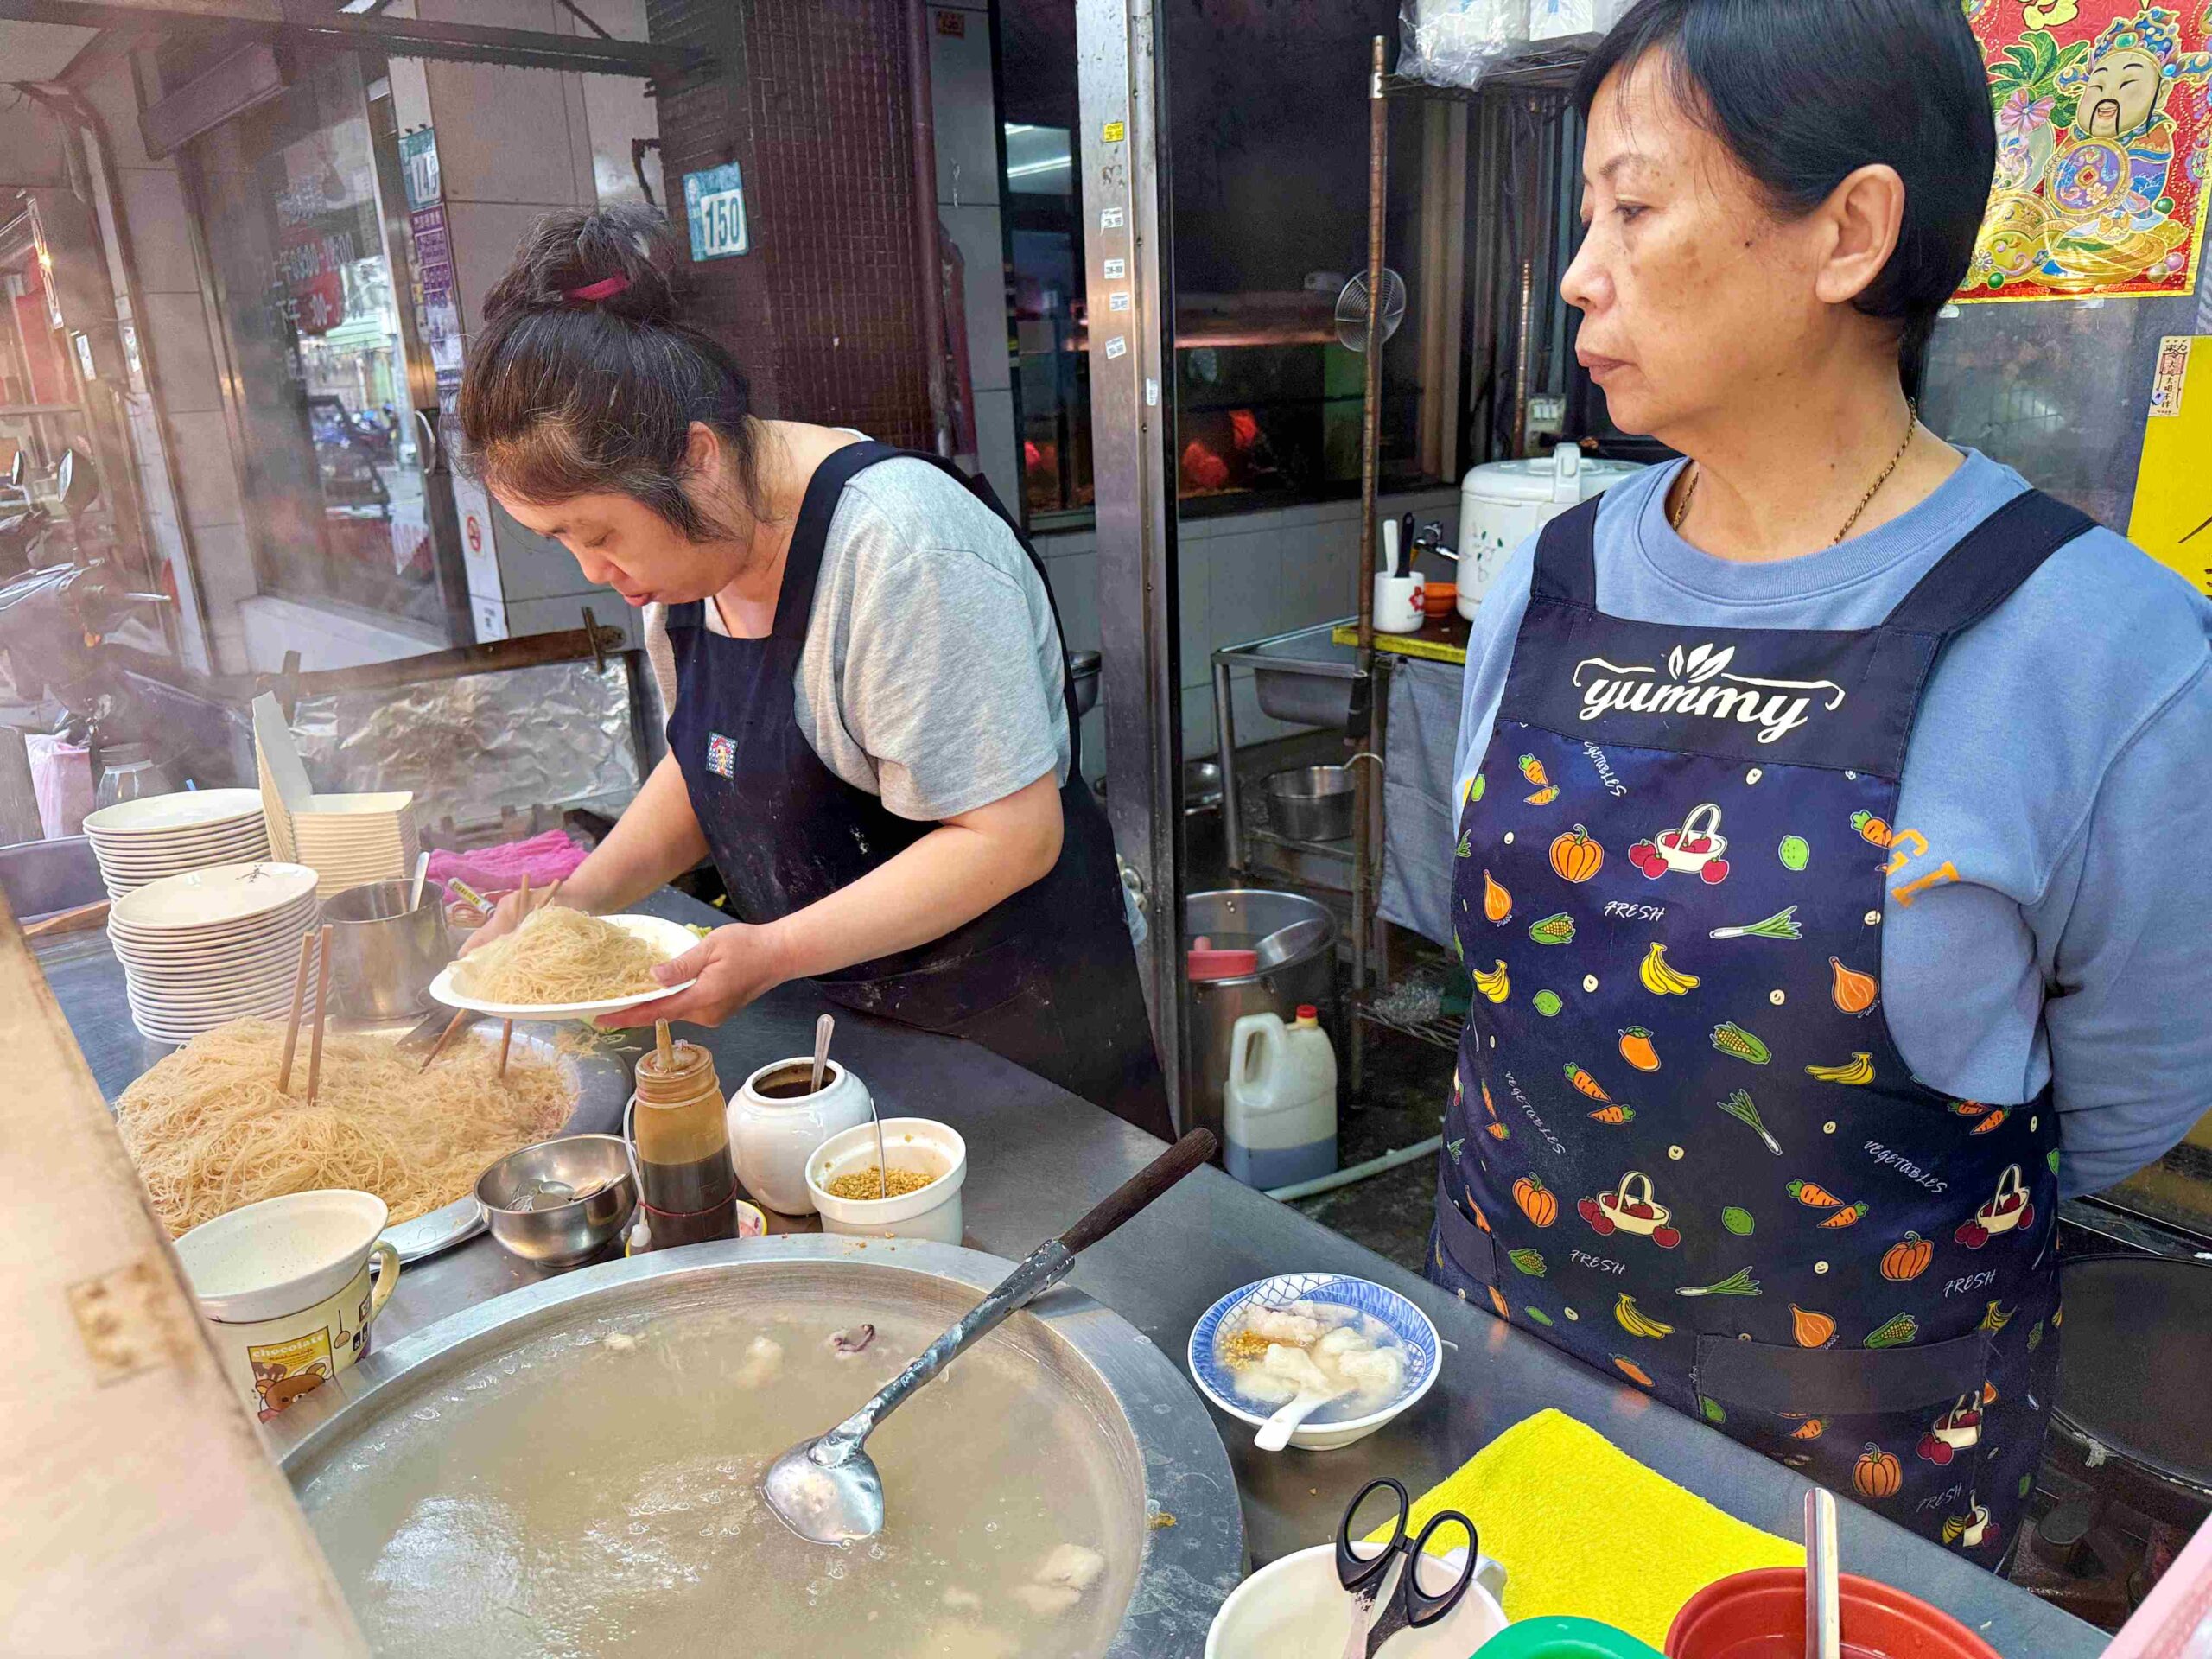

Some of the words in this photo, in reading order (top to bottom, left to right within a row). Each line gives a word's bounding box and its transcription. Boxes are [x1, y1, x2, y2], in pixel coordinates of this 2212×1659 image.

[705, 196, 741, 249] 150
[1579, 678, 1811, 745] yummy
[1582, 741, 1628, 797] EGETABLES
[1603, 900, 1666, 922] FRESH
[1504, 1070, 1567, 1155] VEGETABLES
[1863, 1140, 1948, 1194] VEGETABLES
[1569, 1249, 1626, 1275] FRESH
[1942, 1268, 1997, 1298] FRESH
[251, 1332, 326, 1358] chocolate
[1915, 1481, 1963, 1513] FRESH
